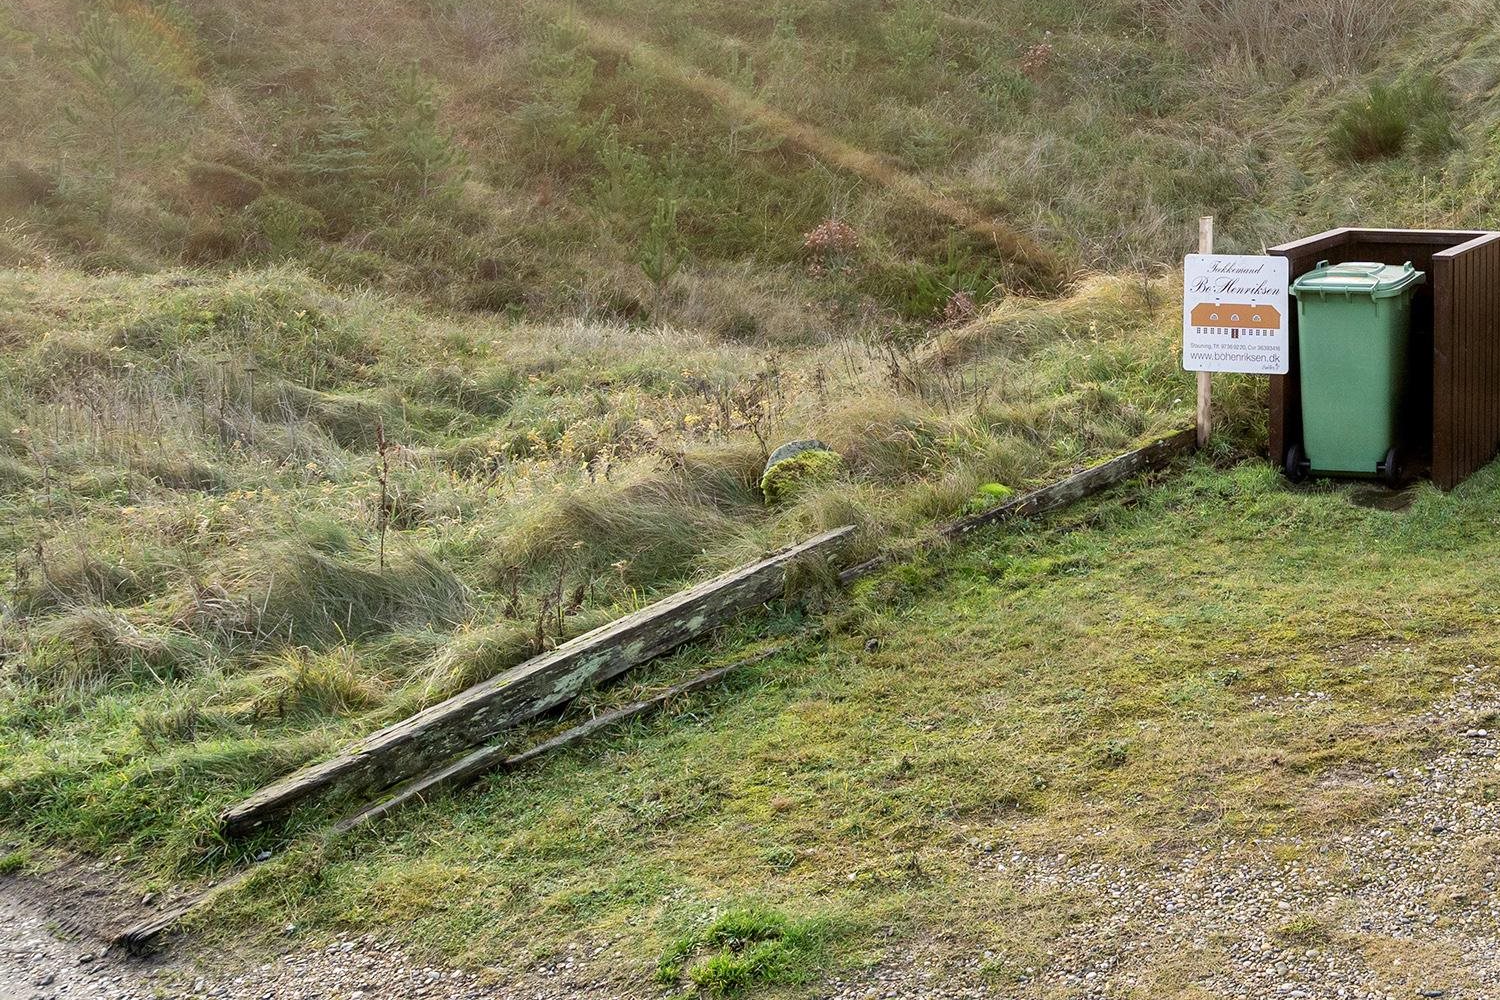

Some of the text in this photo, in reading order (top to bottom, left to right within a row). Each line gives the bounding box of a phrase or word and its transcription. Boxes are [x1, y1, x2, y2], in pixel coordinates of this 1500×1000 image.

[1190, 275, 1281, 296] Bo Henriksen
[1190, 352, 1281, 364] www.bohenriksen.dk
